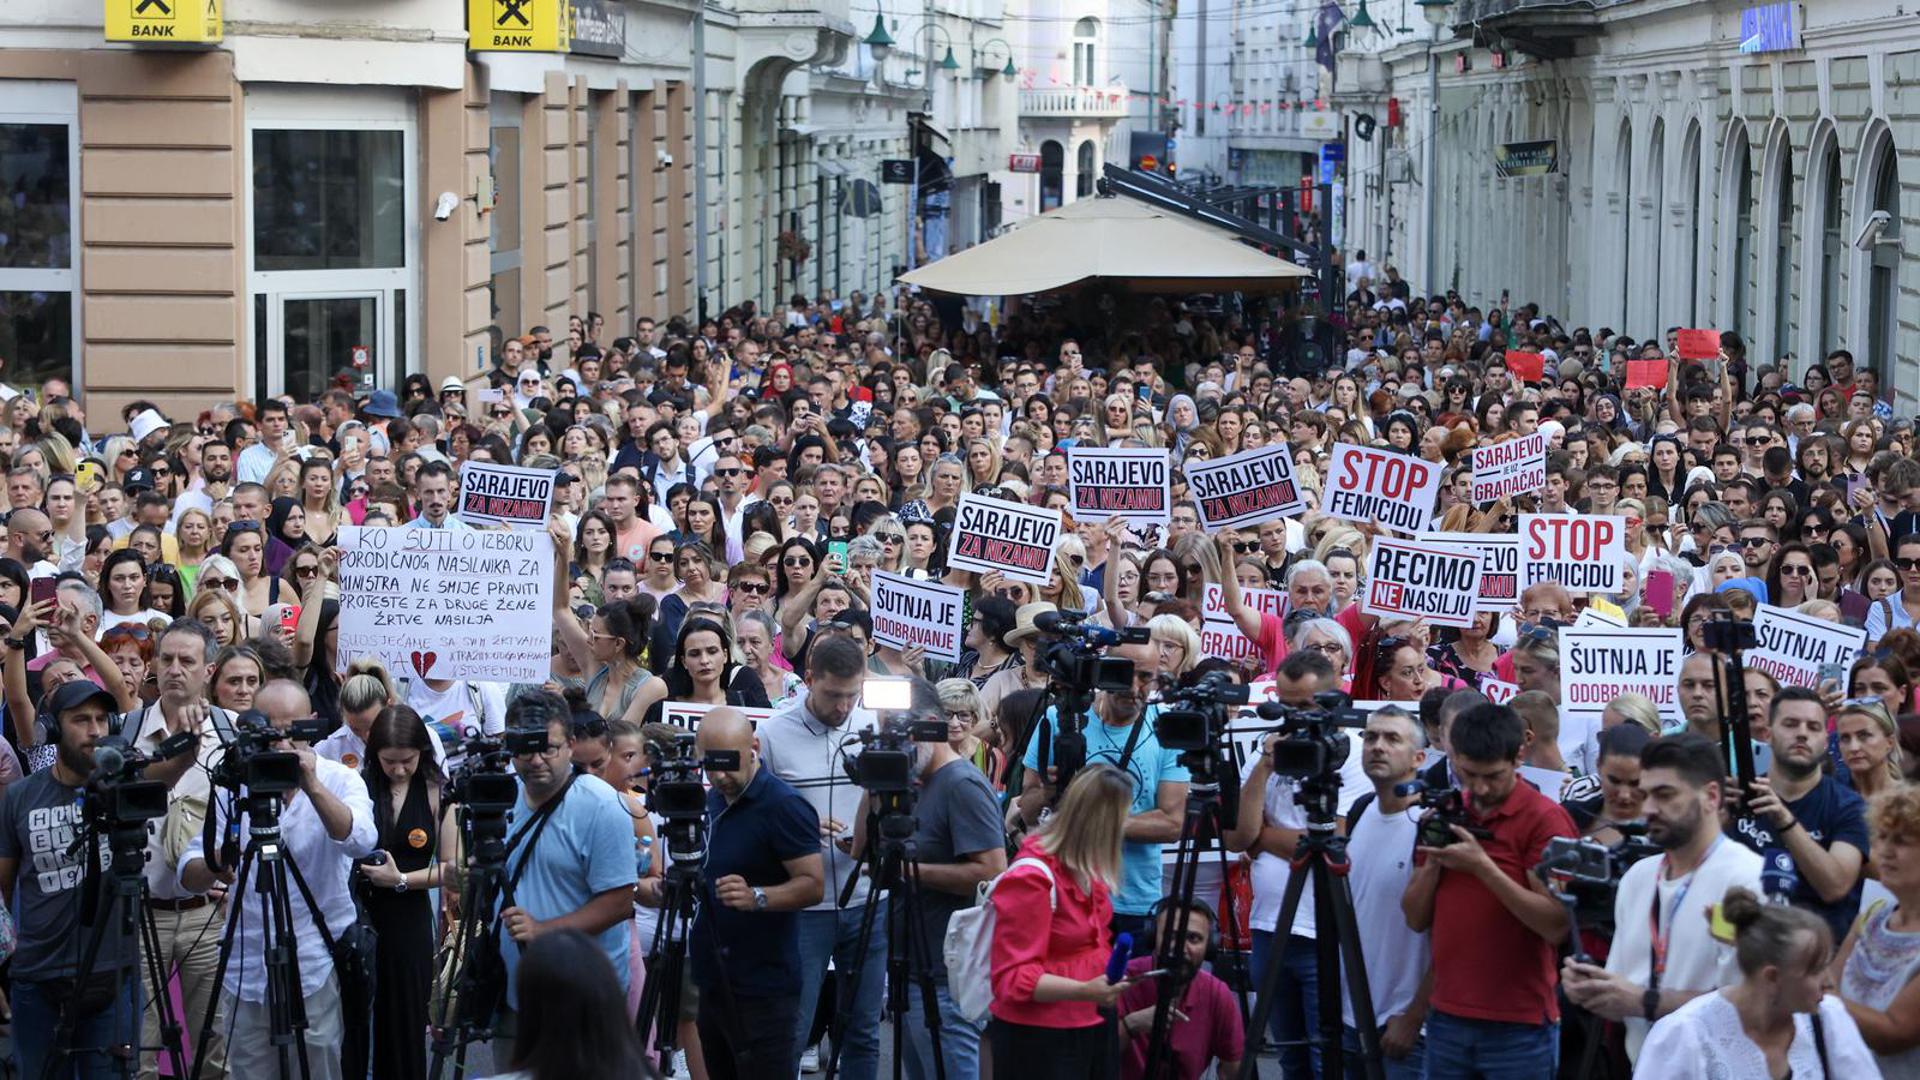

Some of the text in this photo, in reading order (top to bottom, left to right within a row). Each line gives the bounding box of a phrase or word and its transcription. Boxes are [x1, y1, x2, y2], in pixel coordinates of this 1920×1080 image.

[131, 25, 175, 36] BANK
[493, 36, 532, 46] BANK
[1476, 435, 1543, 469] SARAJEVO
[466, 472, 549, 499] SARAJEVO
[1073, 460, 1164, 485] SARAJEVO
[1192, 455, 1290, 498] SARAJEVO
[1339, 450, 1428, 502] STOP
[1475, 468, 1543, 501] GRADAČAC
[1503, 463, 1518, 475] JE UZ
[467, 494, 544, 519] ZA NIZAMU
[1078, 487, 1161, 509] ZA NIZAMU
[1204, 481, 1294, 520] ZA NIZAMU
[1330, 491, 1423, 531] FEMICIDU
[360, 528, 534, 552] KO ŠUTI O IZBORU
[960, 506, 1056, 546] SARAJEVO
[1529, 518, 1614, 561] STOP
[338, 550, 540, 576] PORODIČNOG NASILNIKA ZA
[959, 534, 1047, 570] ZA NIZAMU
[339, 574, 539, 596] MINISTRA NE SMIJE PRAVITI
[1373, 547, 1476, 592] RECIMO
[1527, 562, 1614, 588] FEMICIDU
[340, 594, 536, 611] PROTESTE ZA DRUGE ŽENE
[877, 583, 956, 626] ŠUTNJA JE
[1374, 583, 1471, 616] NE NASILJU
[374, 611, 494, 626] ŽRTVE NASILJA
[875, 616, 954, 650] ODOBRAVANJE
[1201, 631, 1261, 659] GRADA
[1757, 619, 1826, 662] ŠUTNJA
[1570, 642, 1675, 676] ŠUTNJA JE
